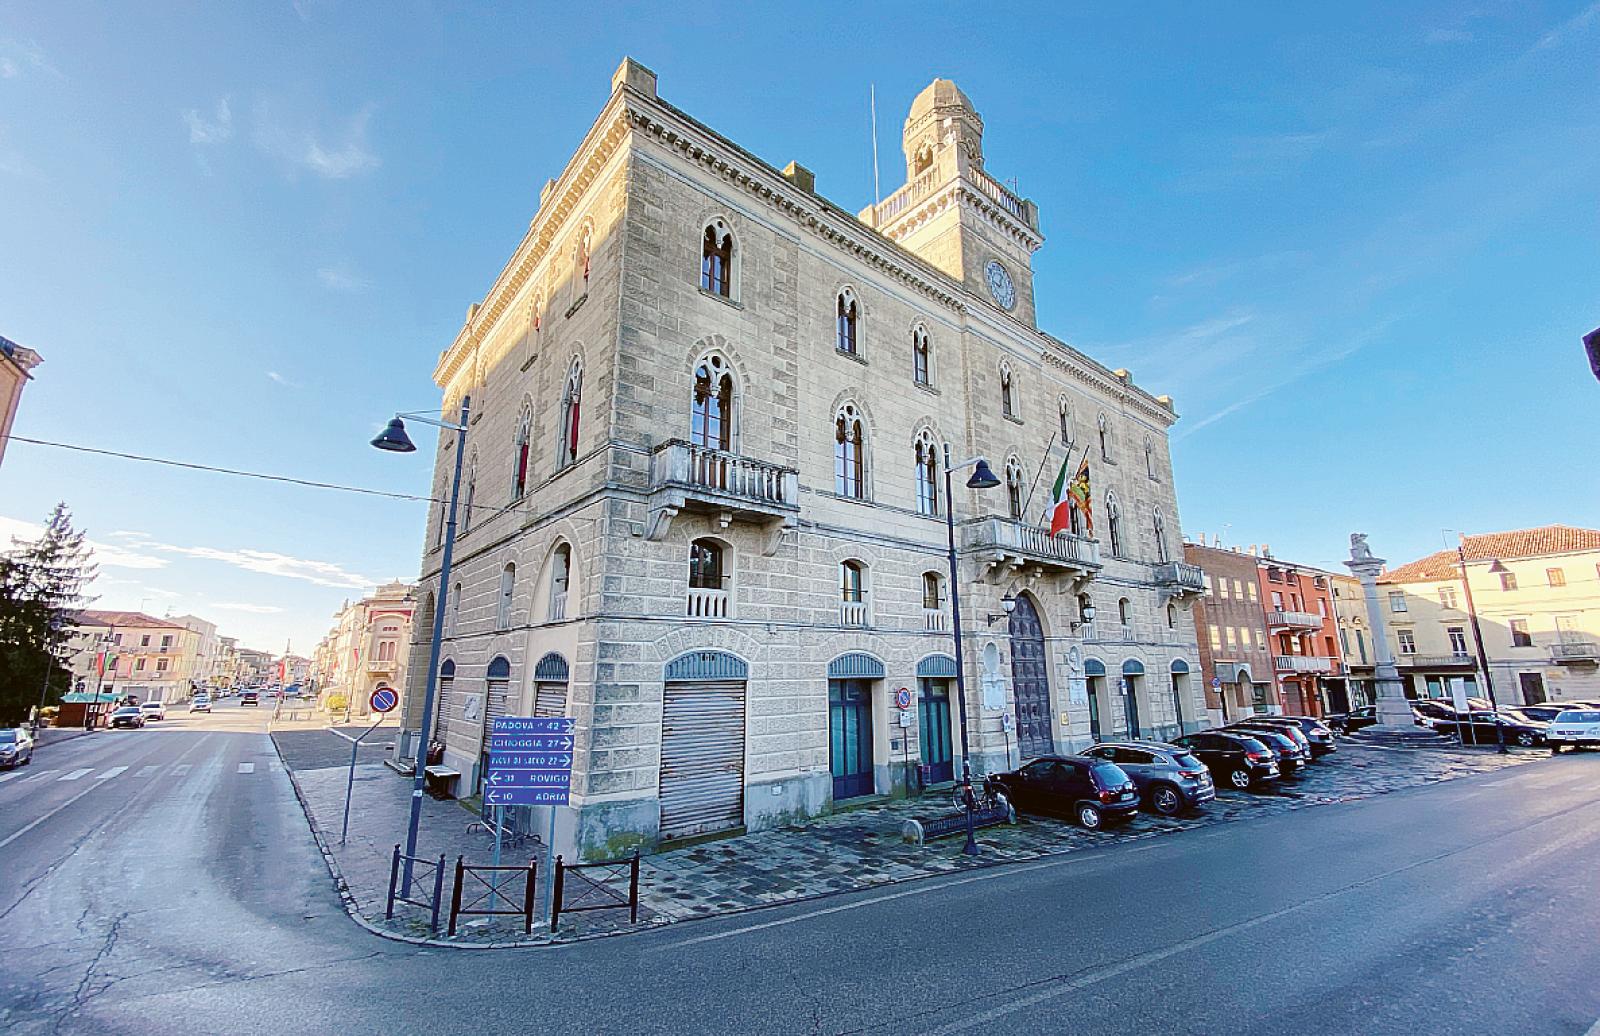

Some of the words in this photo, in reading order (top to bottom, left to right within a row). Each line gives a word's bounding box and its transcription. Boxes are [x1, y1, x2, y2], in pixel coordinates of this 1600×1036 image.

[495, 722, 534, 730] PADOVA
[547, 722, 559, 730] 42
[548, 740, 559, 748] 27
[530, 774, 568, 783] ROVIGO
[536, 792, 566, 800] ADRIA
